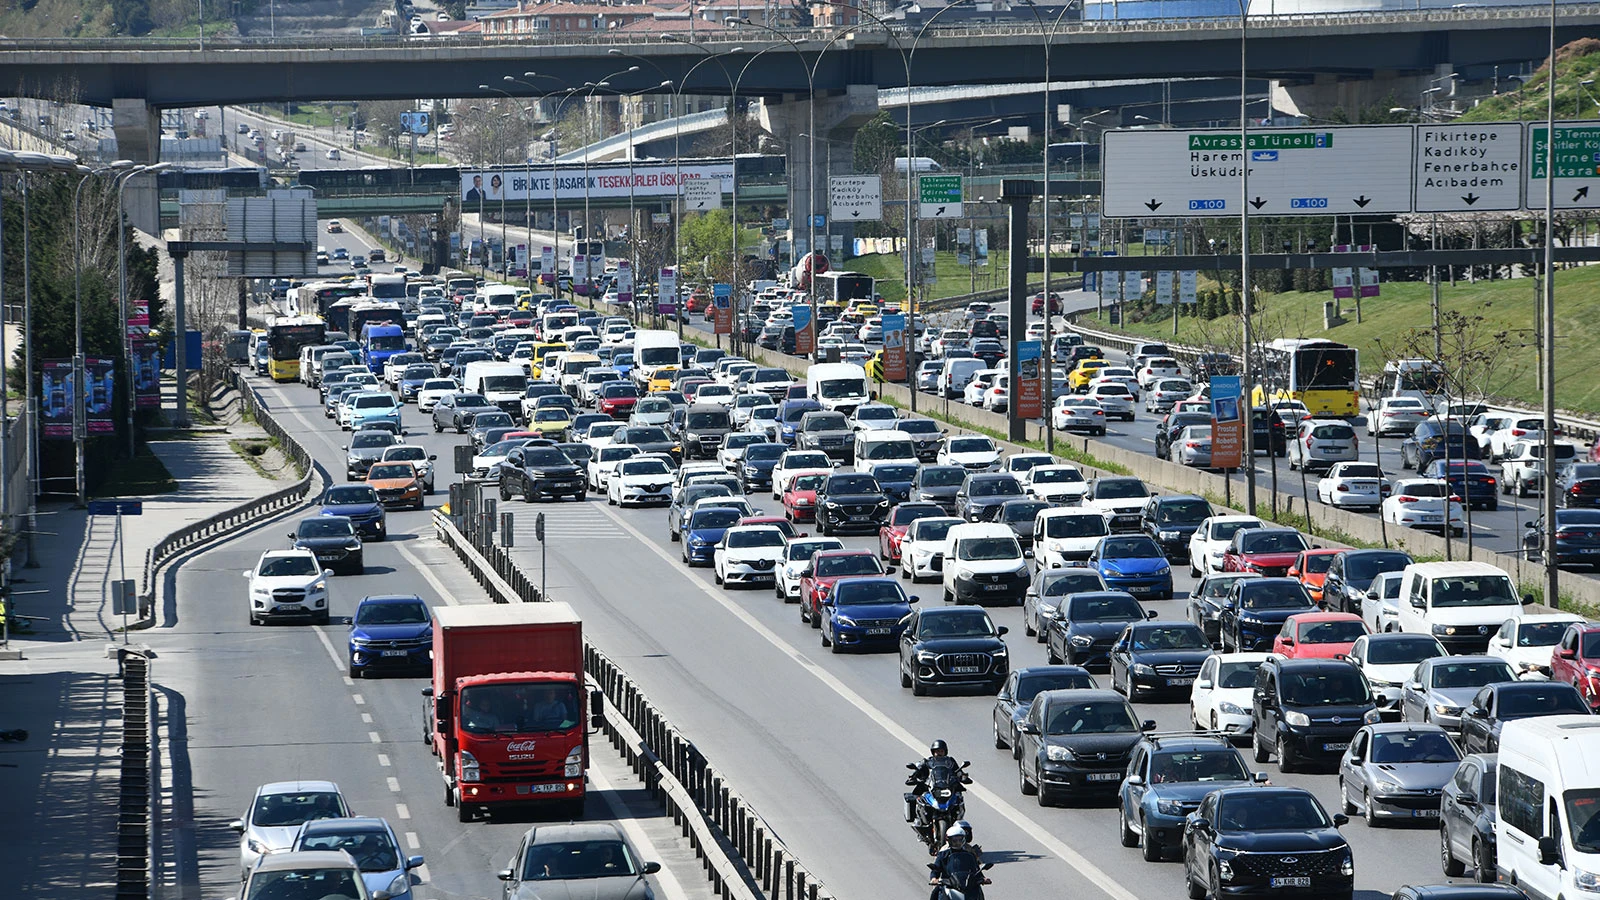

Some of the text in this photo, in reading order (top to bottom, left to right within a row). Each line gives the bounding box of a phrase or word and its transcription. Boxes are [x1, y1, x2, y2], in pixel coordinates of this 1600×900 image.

[1192, 135, 1314, 149] Avrasya Tüneli
[1425, 131, 1498, 143] Fikirtepe
[1584, 140, 1600, 150] Kö
[1190, 152, 1243, 162] Harem
[1424, 146, 1487, 158] Kadıköy
[1535, 153, 1589, 163] Eirne
[1190, 165, 1253, 177] Üsküdar
[1424, 161, 1518, 172] Fenerbahçe
[1535, 166, 1593, 176] Akara
[1424, 177, 1503, 188] Acıbadem
[1191, 200, 1224, 209] D.100
[1293, 199, 1326, 208] D.100
